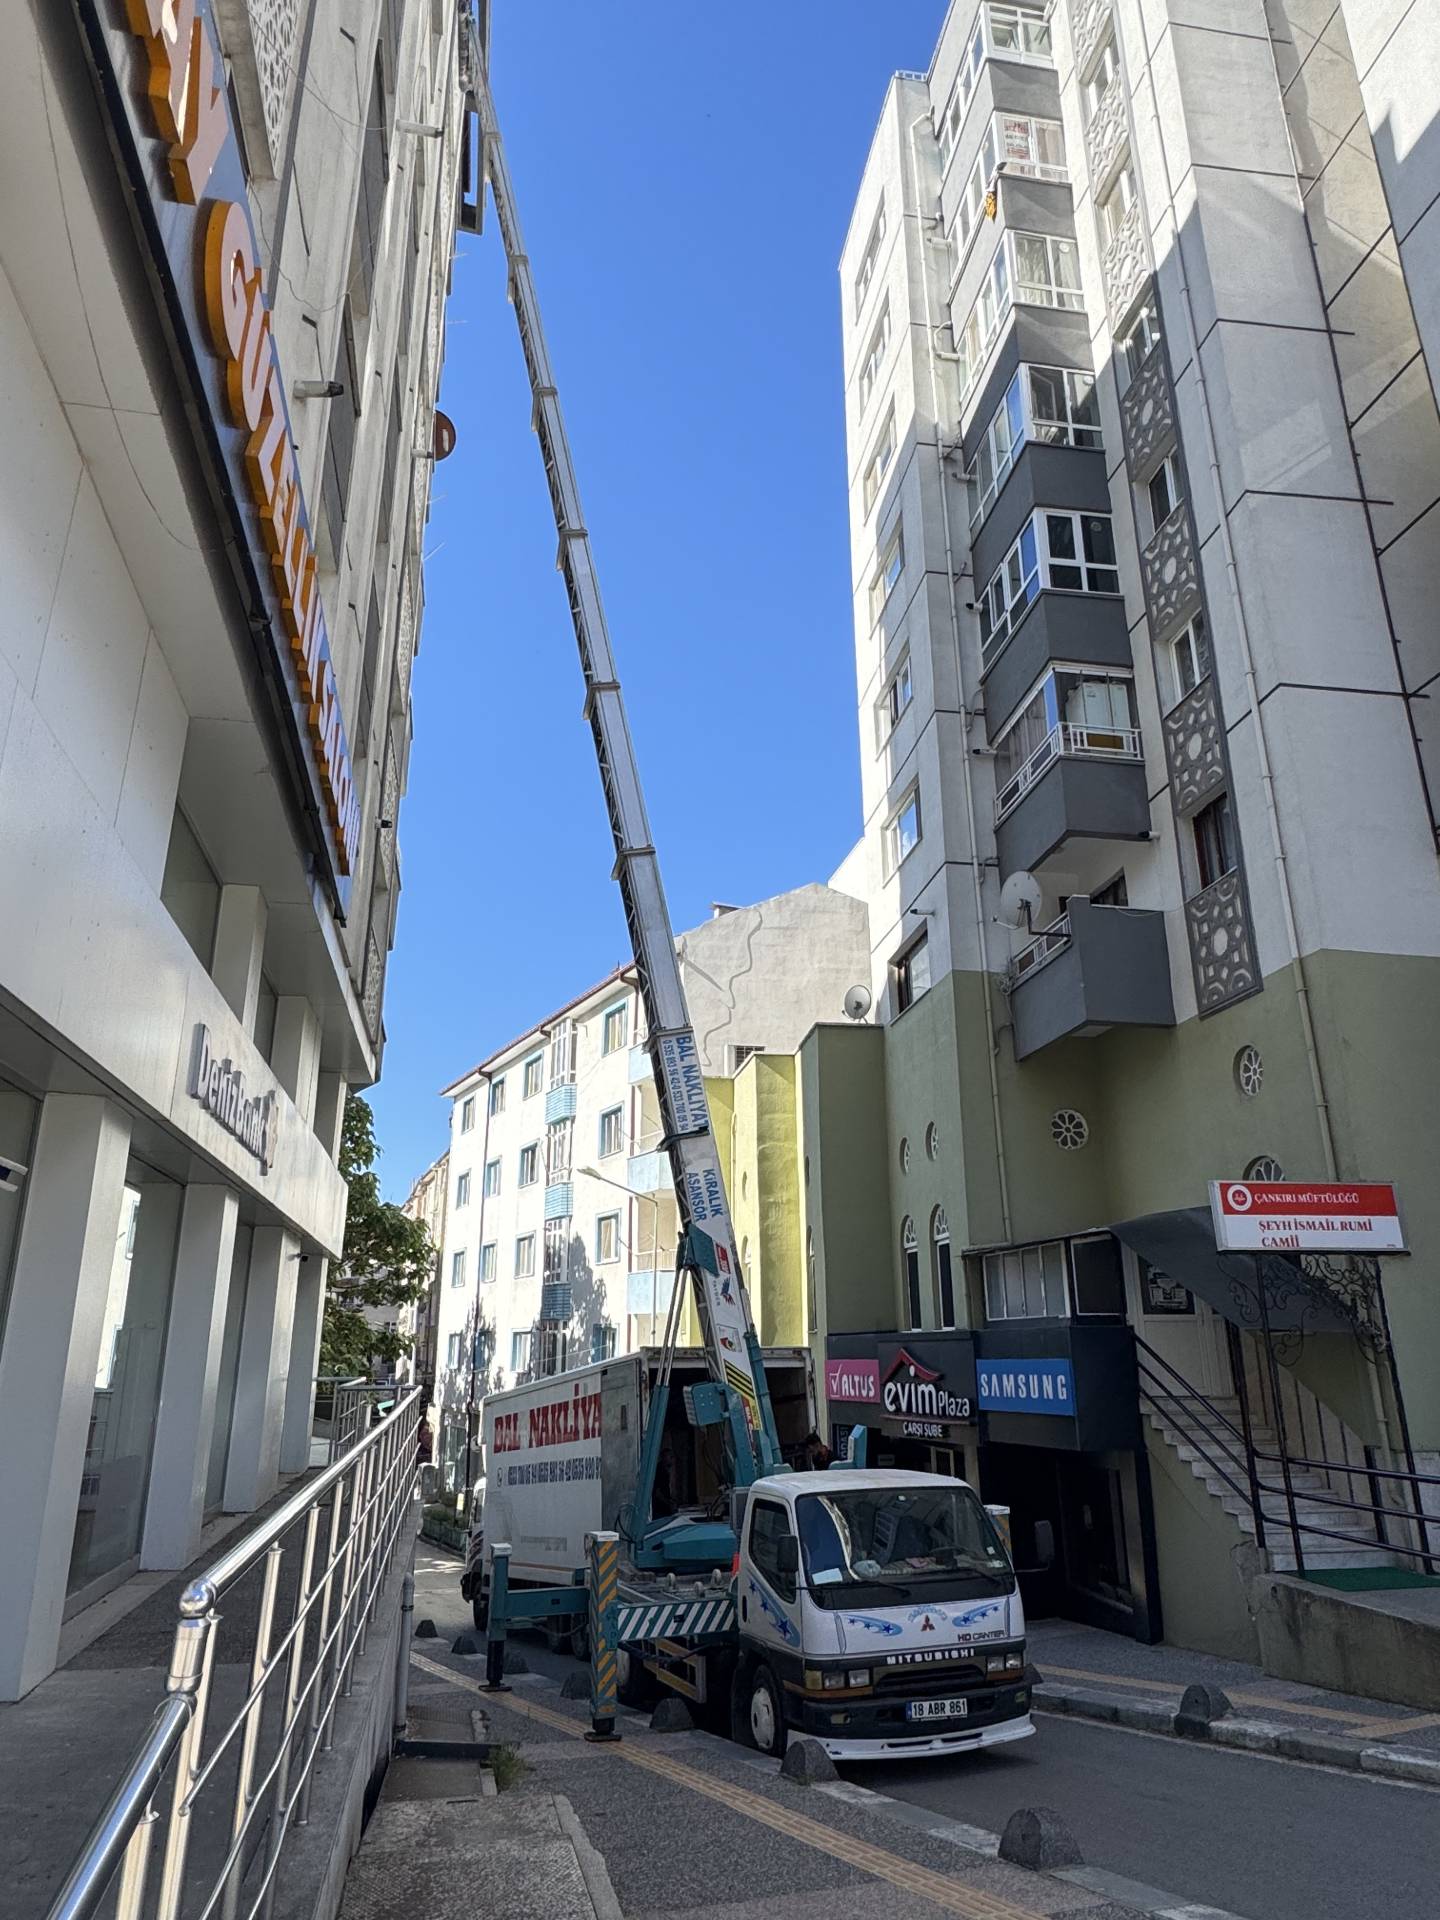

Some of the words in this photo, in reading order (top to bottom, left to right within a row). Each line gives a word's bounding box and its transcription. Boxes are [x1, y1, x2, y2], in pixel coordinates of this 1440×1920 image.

[675, 1036, 695, 1062] BAL
[1254, 1192, 1296, 1205] ÇANKIRI
[1258, 1220, 1293, 1233] ŞEYH
[1294, 1217, 1340, 1232] İSMAİL
[1340, 1218, 1373, 1232] RUMİ
[1261, 1235, 1300, 1248] CAMİİ
[841, 1374, 875, 1399] ALTUS
[980, 1373, 1068, 1401] SAMSUNG
[887, 1648, 975, 1664] MITSUBISHI
[913, 1703, 924, 1717] 18
[927, 1702, 946, 1716] ABR
[949, 1700, 967, 1715] 861
